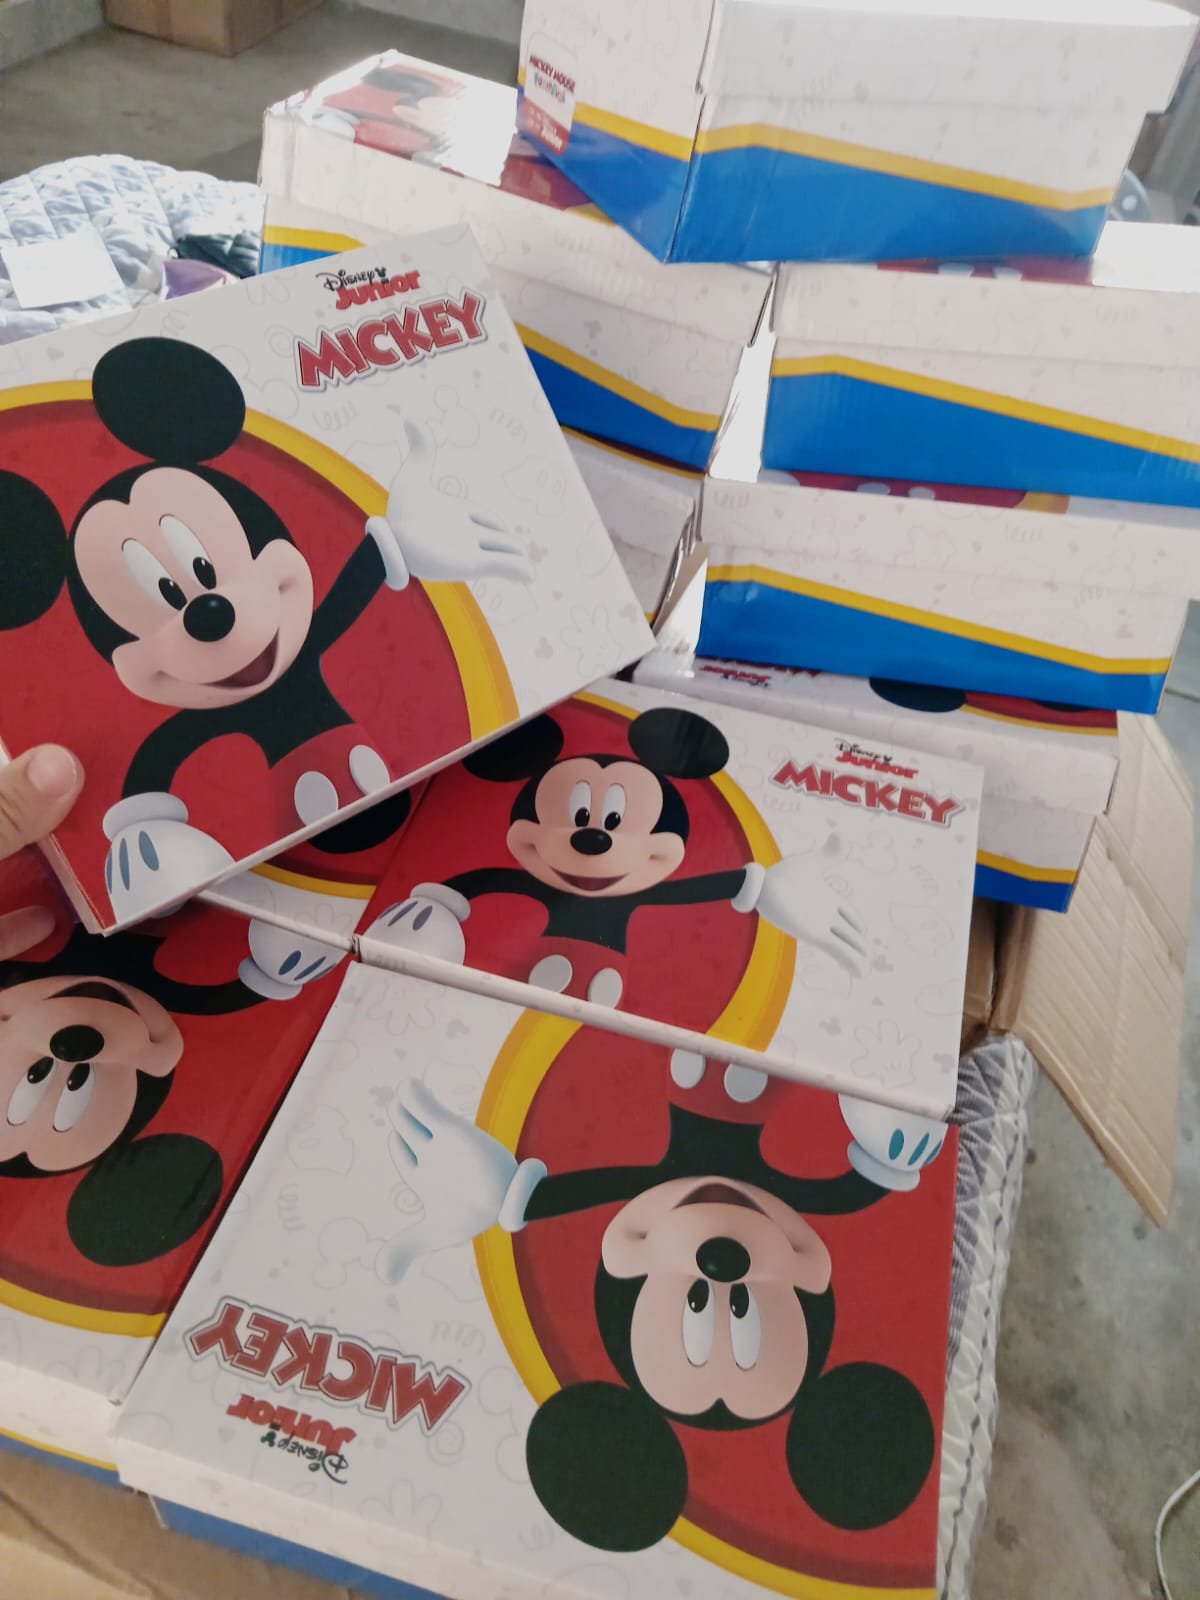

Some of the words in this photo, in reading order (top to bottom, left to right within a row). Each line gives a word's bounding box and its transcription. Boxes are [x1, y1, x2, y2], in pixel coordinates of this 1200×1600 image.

[315, 268, 375, 292] Disney
[335, 269, 421, 311] Junior
[296, 289, 483, 388] MICKEY
[772, 759, 961, 825] MICKEY
[835, 751, 919, 779] Junior
[189, 1302, 466, 1432] MICKEY
[225, 1393, 358, 1455] Junior
[277, 1433, 349, 1484] Disney
